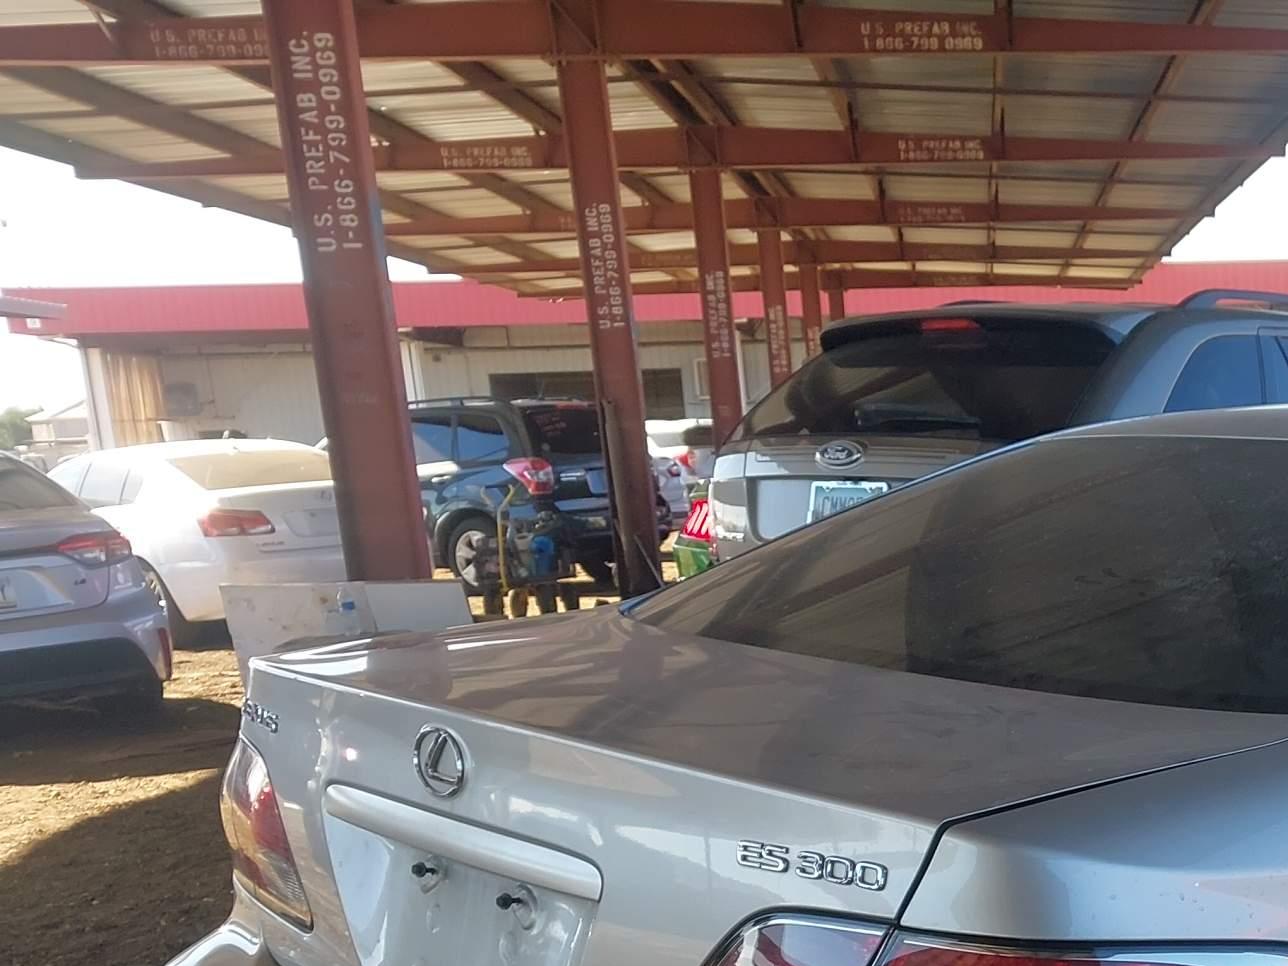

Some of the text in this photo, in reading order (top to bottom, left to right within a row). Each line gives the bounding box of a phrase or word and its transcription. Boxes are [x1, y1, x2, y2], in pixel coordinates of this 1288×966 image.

[288, 31, 337, 252] U.S. PREFAB INC.
[313, 32, 363, 249] 1-866-799-0969
[585, 202, 600, 232] INC.
[588, 237, 608, 295] PREFAB
[598, 203, 626, 328] 1-866-799-0969
[737, 839, 889, 892] ES 300
